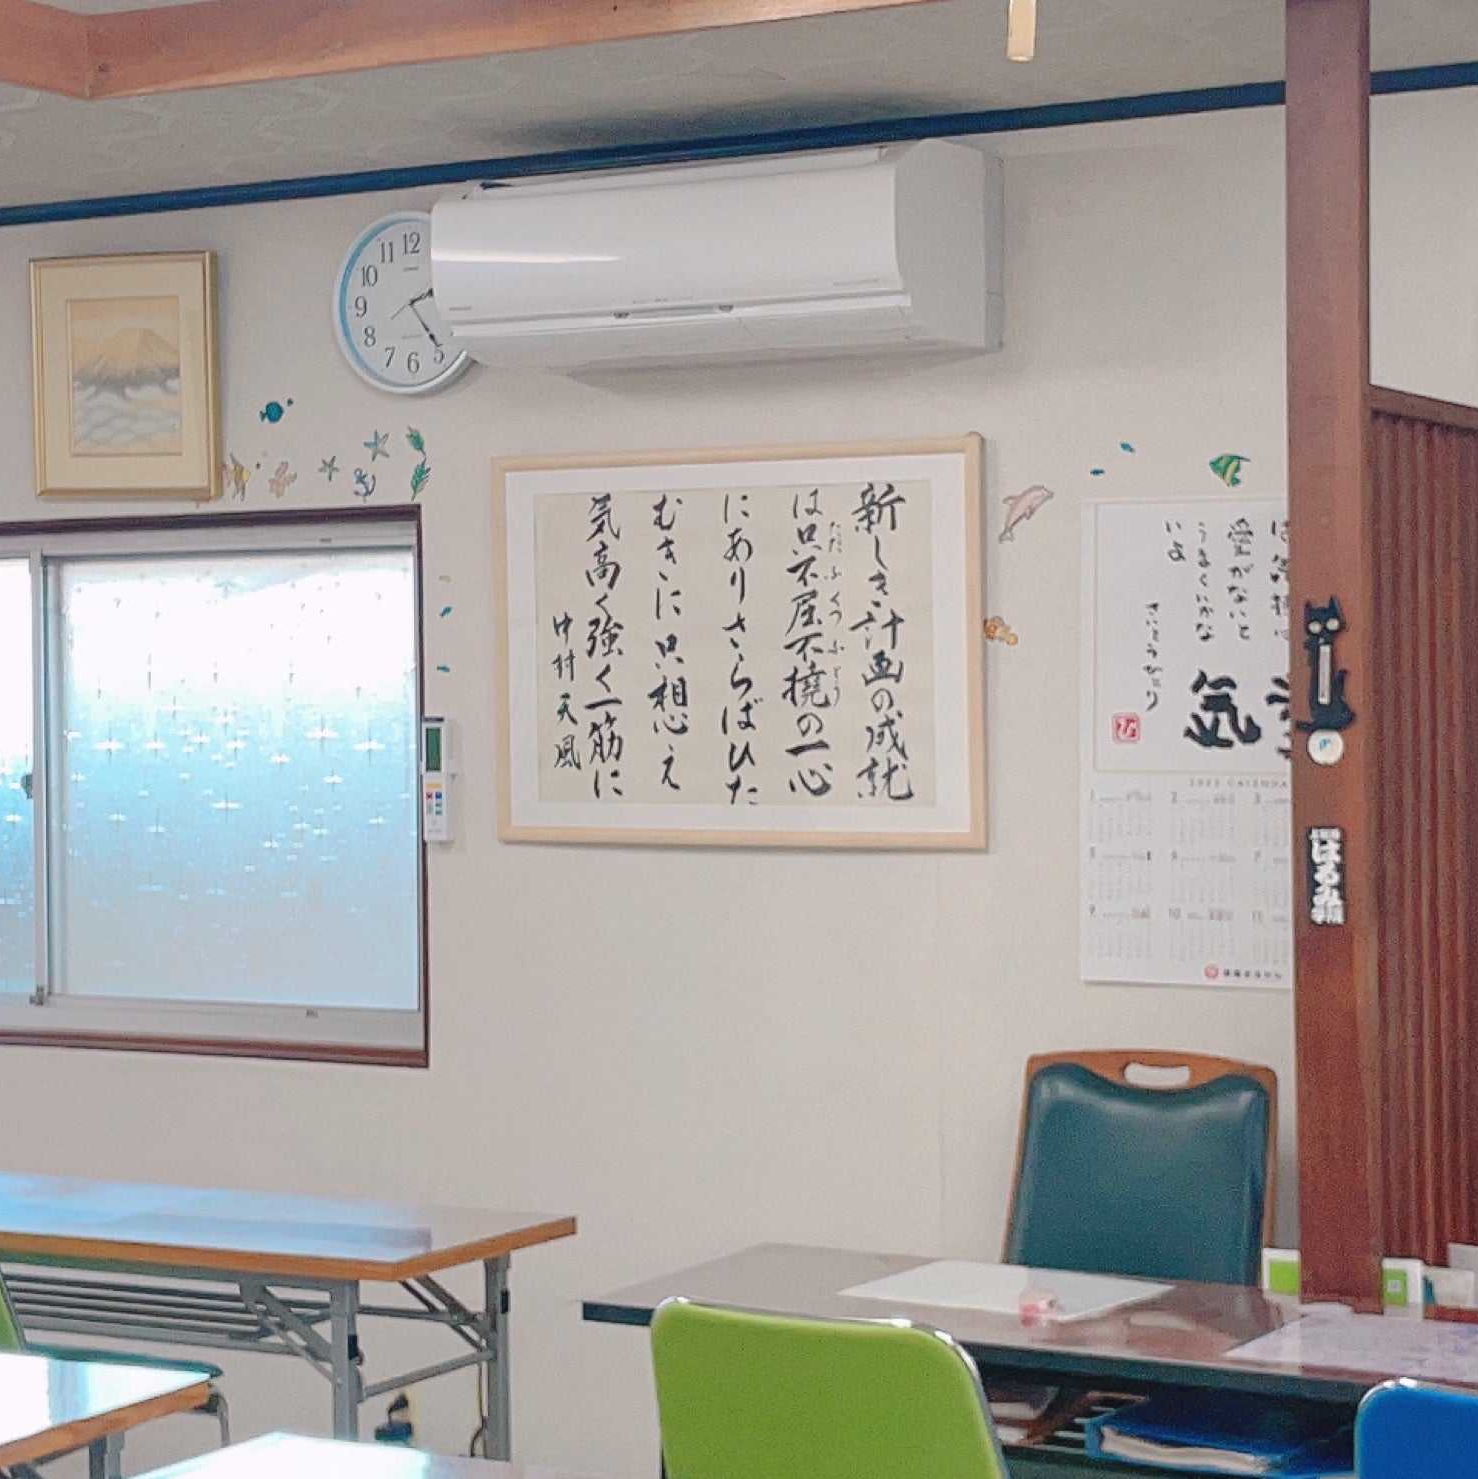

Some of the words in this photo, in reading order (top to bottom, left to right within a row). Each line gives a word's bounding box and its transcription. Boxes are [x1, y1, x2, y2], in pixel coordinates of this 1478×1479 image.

[380, 241, 394, 263] 11
[402, 232, 421, 255] 12
[361, 265, 378, 287] 10
[354, 296, 367, 318] 9
[364, 327, 376, 347] 8
[384, 346, 396, 368] 7
[407, 352, 420, 374] 6
[433, 345, 445, 364] 5
[584, 494, 623, 797] 気高く強く一筋に
[552, 611, 582, 770] 中村天風
